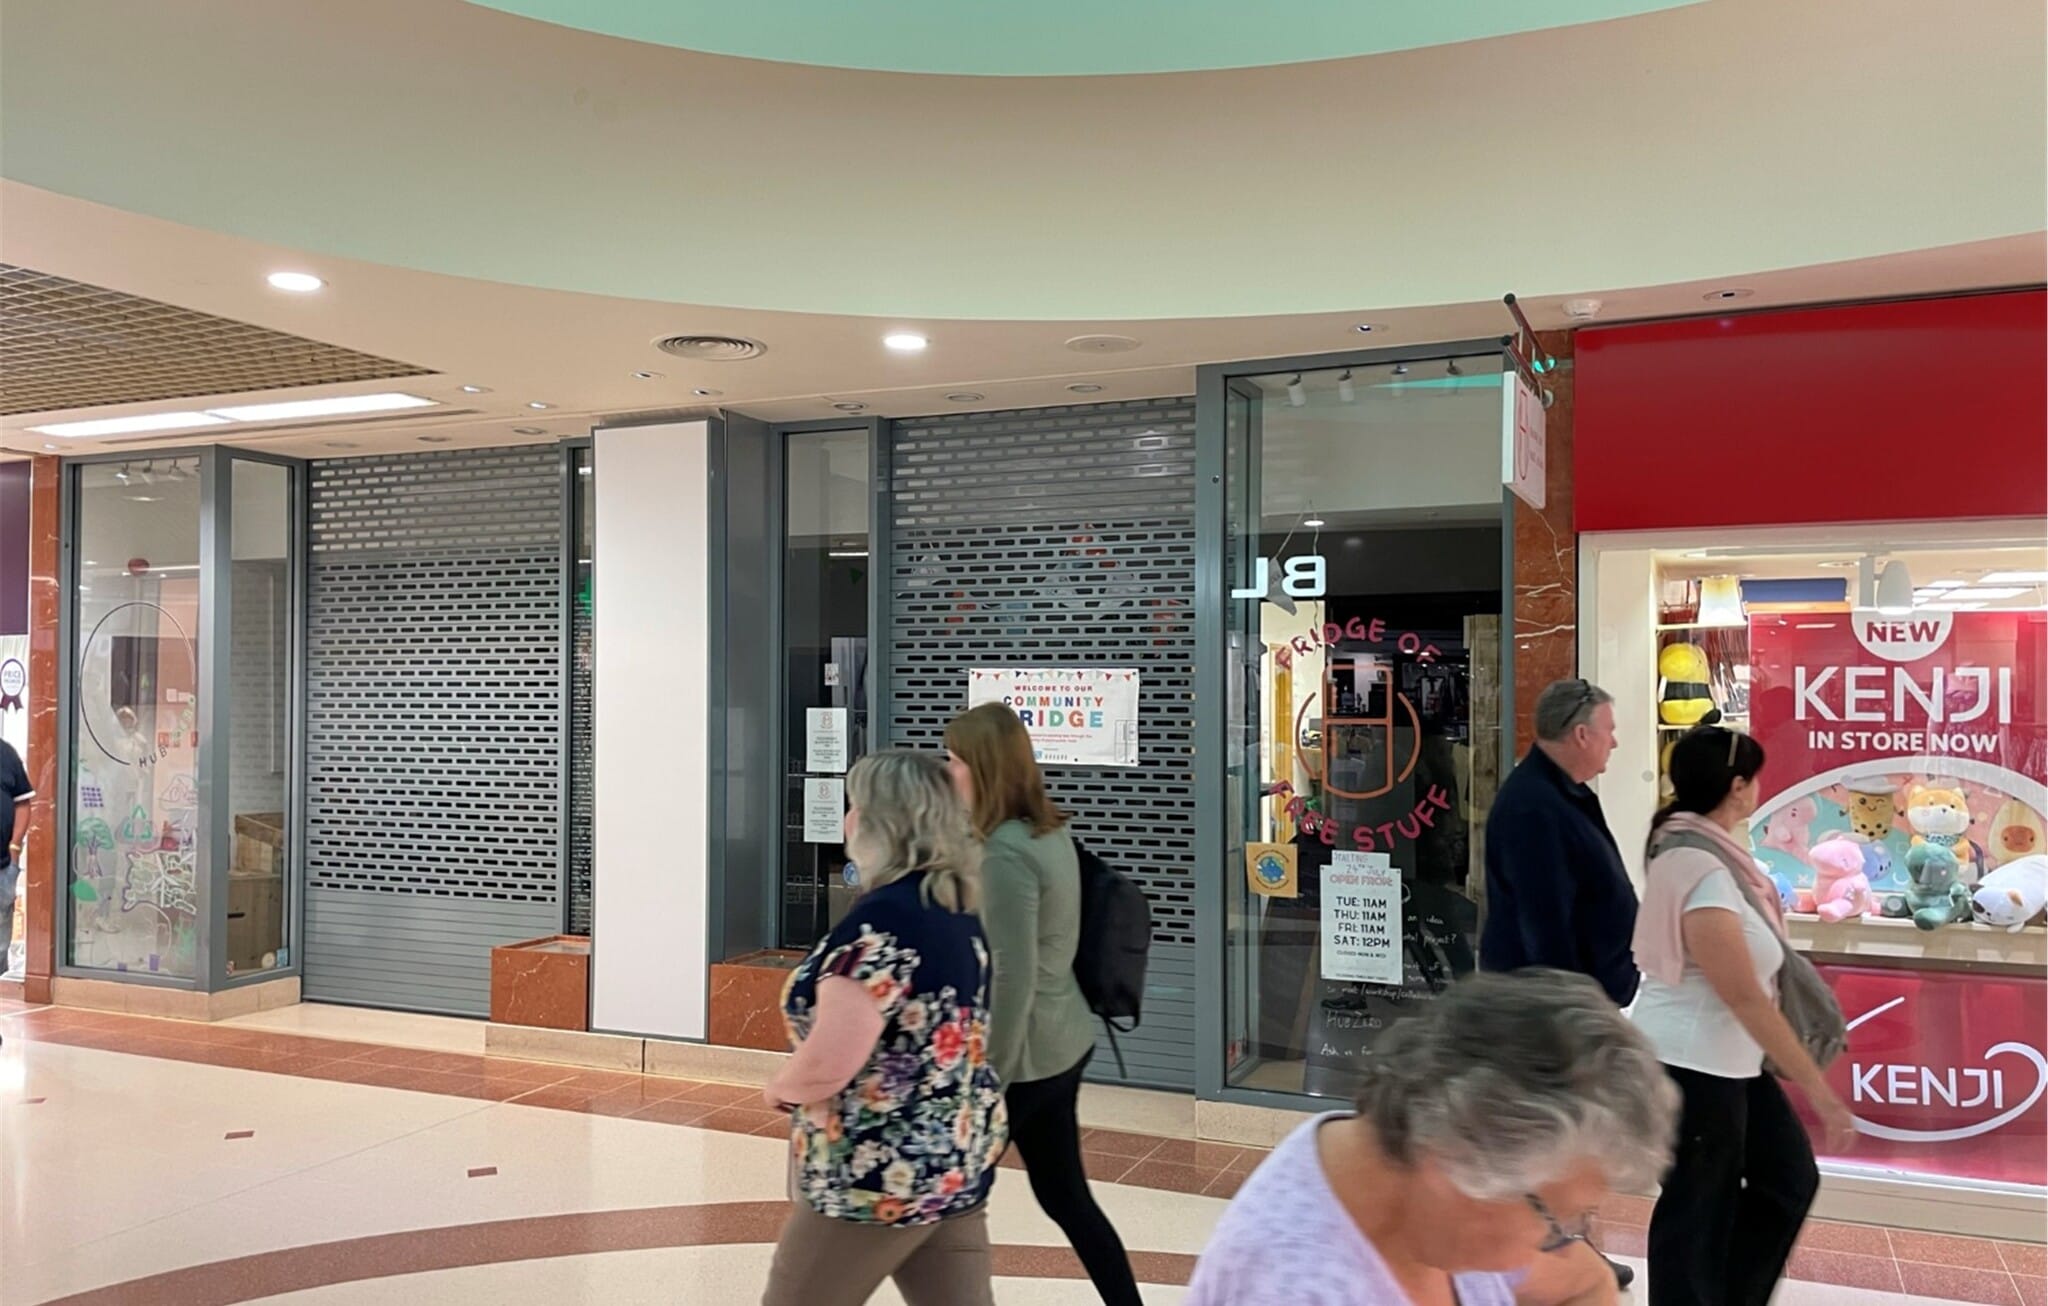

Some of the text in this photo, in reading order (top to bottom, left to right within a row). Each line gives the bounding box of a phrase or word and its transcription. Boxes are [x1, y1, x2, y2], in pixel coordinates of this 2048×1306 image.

[1866, 620, 1940, 643] NEW
[1275, 617, 1442, 669] FRIDGE OF
[1003, 695, 1104, 707] COMMUNITY
[1794, 666, 2012, 724] KENJI
[1019, 710, 1104, 728] RIDGE
[1808, 730, 1999, 754] IN STORE NOW
[139, 746, 167, 767] HUB
[1353, 784, 1451, 853] STUFF
[1329, 873, 1359, 885] OPEN
[1336, 896, 1387, 908] TUE: 11AM
[1334, 909, 1386, 921] THU: 11AM
[1338, 922, 1385, 934] FRI: 11AM
[1334, 935, 1390, 948] SAT: 12PM
[1851, 1063, 2003, 1109] KENJI
